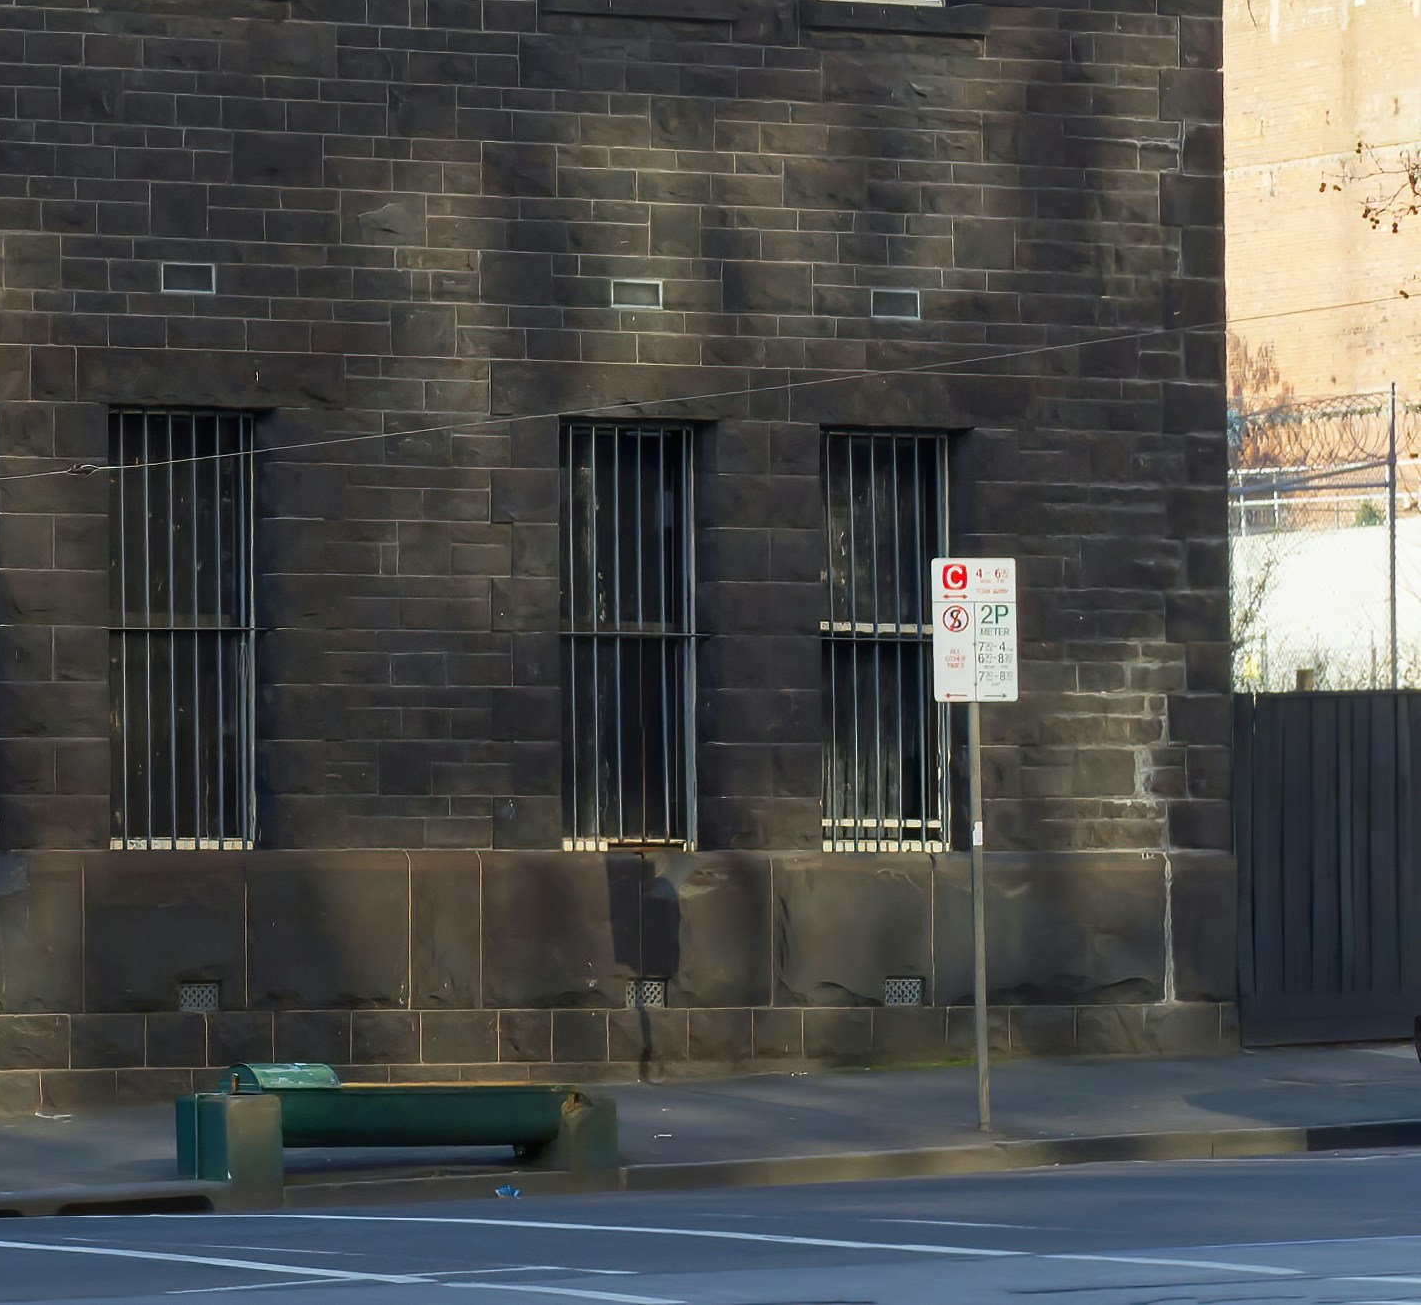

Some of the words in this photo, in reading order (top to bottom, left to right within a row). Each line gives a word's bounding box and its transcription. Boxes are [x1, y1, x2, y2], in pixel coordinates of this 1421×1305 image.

[946, 566, 964, 589] C
[980, 604, 1009, 625] 2P
[980, 627, 1010, 636] METER
